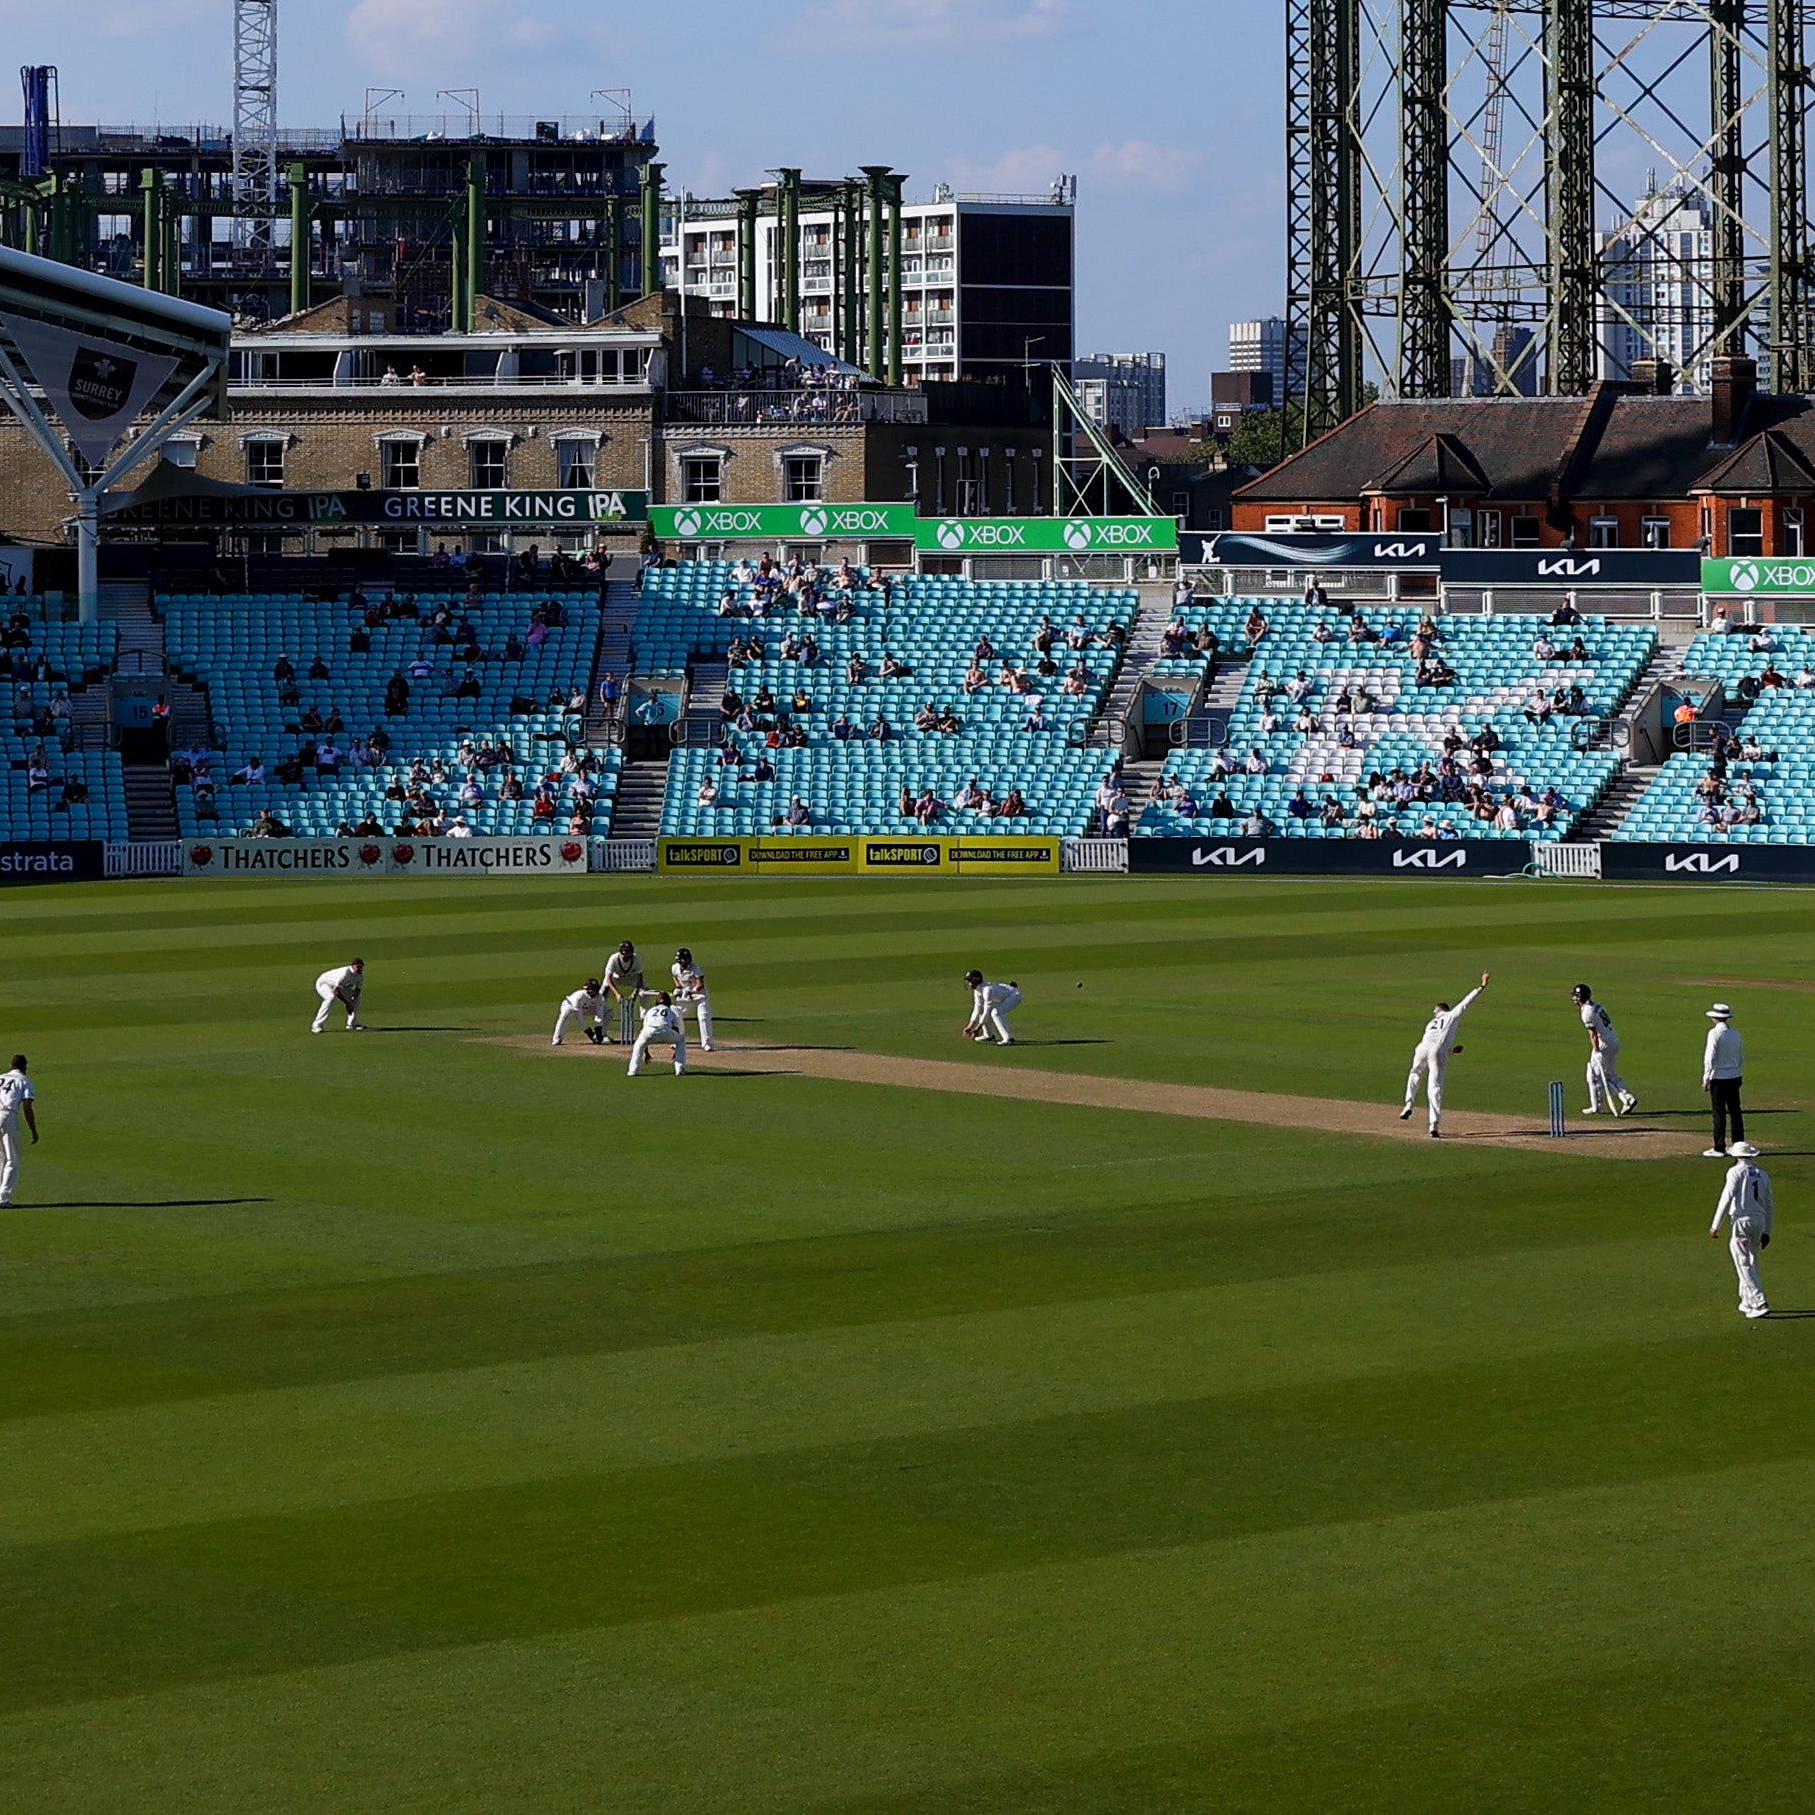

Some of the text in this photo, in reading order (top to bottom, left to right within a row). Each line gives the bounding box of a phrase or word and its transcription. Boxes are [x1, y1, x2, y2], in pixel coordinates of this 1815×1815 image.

[74, 378, 123, 401] SURREY
[224, 495, 295, 519] KING
[306, 494, 348, 520] IPA
[384, 492, 627, 519] GREENE KING IPA
[705, 511, 762, 531] XBOX
[832, 510, 889, 530] XBOX
[968, 525, 1026, 545] XBOX
[1095, 524, 1153, 544] XBOX
[133, 705, 148, 719] 15
[1164, 701, 1178, 715] 17
[219, 845, 350, 869] THATCHERS
[421, 843, 551, 868] THATCHERS
[669, 848, 723, 862] talkSPORT
[750, 849, 838, 860] DOWNLOAD THE FREE APP
[869, 847, 923, 861] talkSPORT
[951, 850, 1040, 860] DOWNLOAD THE FREE APP
[1430, 1018, 1444, 1030] 21
